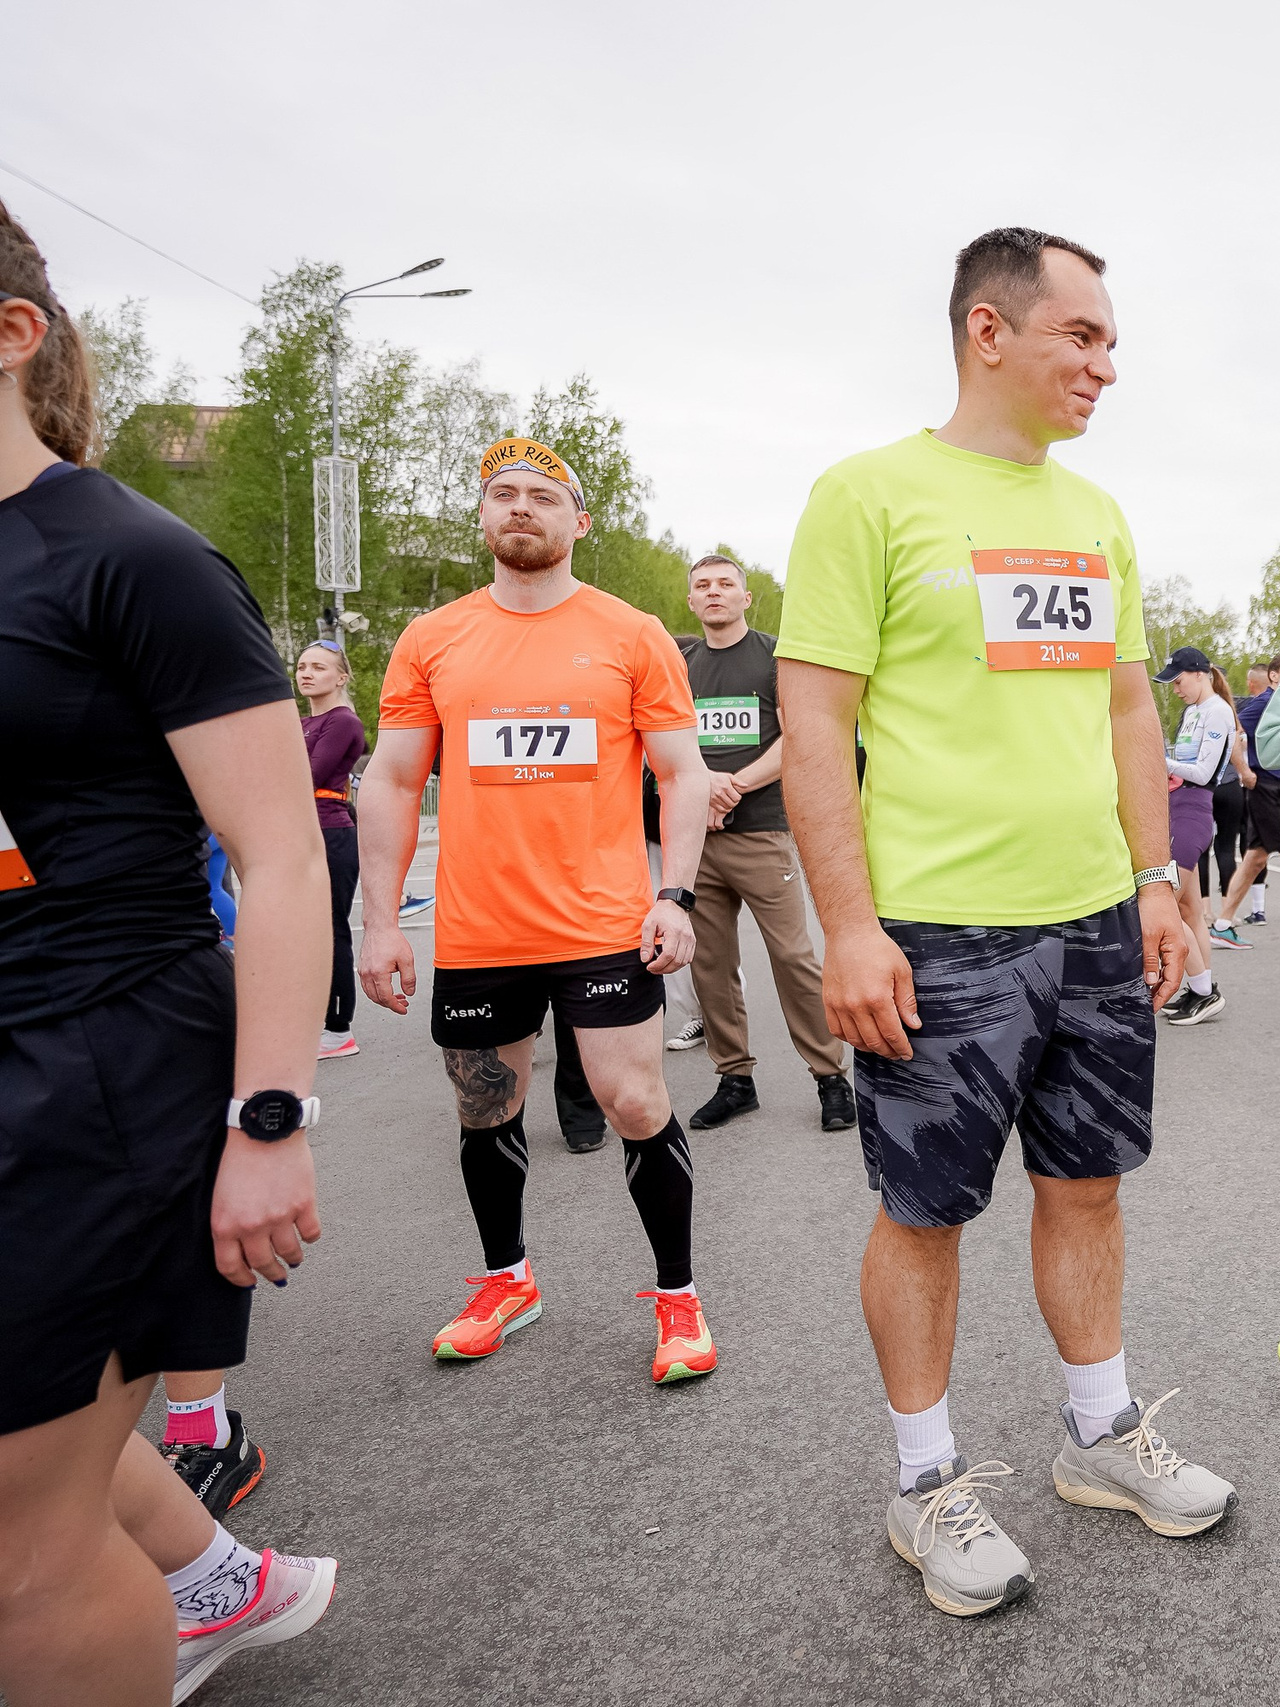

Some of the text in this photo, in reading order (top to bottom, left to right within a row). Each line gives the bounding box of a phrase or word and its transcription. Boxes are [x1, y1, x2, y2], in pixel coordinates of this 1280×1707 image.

[525, 446, 560, 473] RIDE
[1015, 557, 1034, 565] СБЕР
[1013, 584, 1092, 630] 245
[700, 711, 752, 730] 1300
[496, 725, 570, 757] 177
[589, 982, 624, 995] ASRV
[449, 1007, 487, 1019] ASRV
[265, 1102, 282, 1131] 11:13
